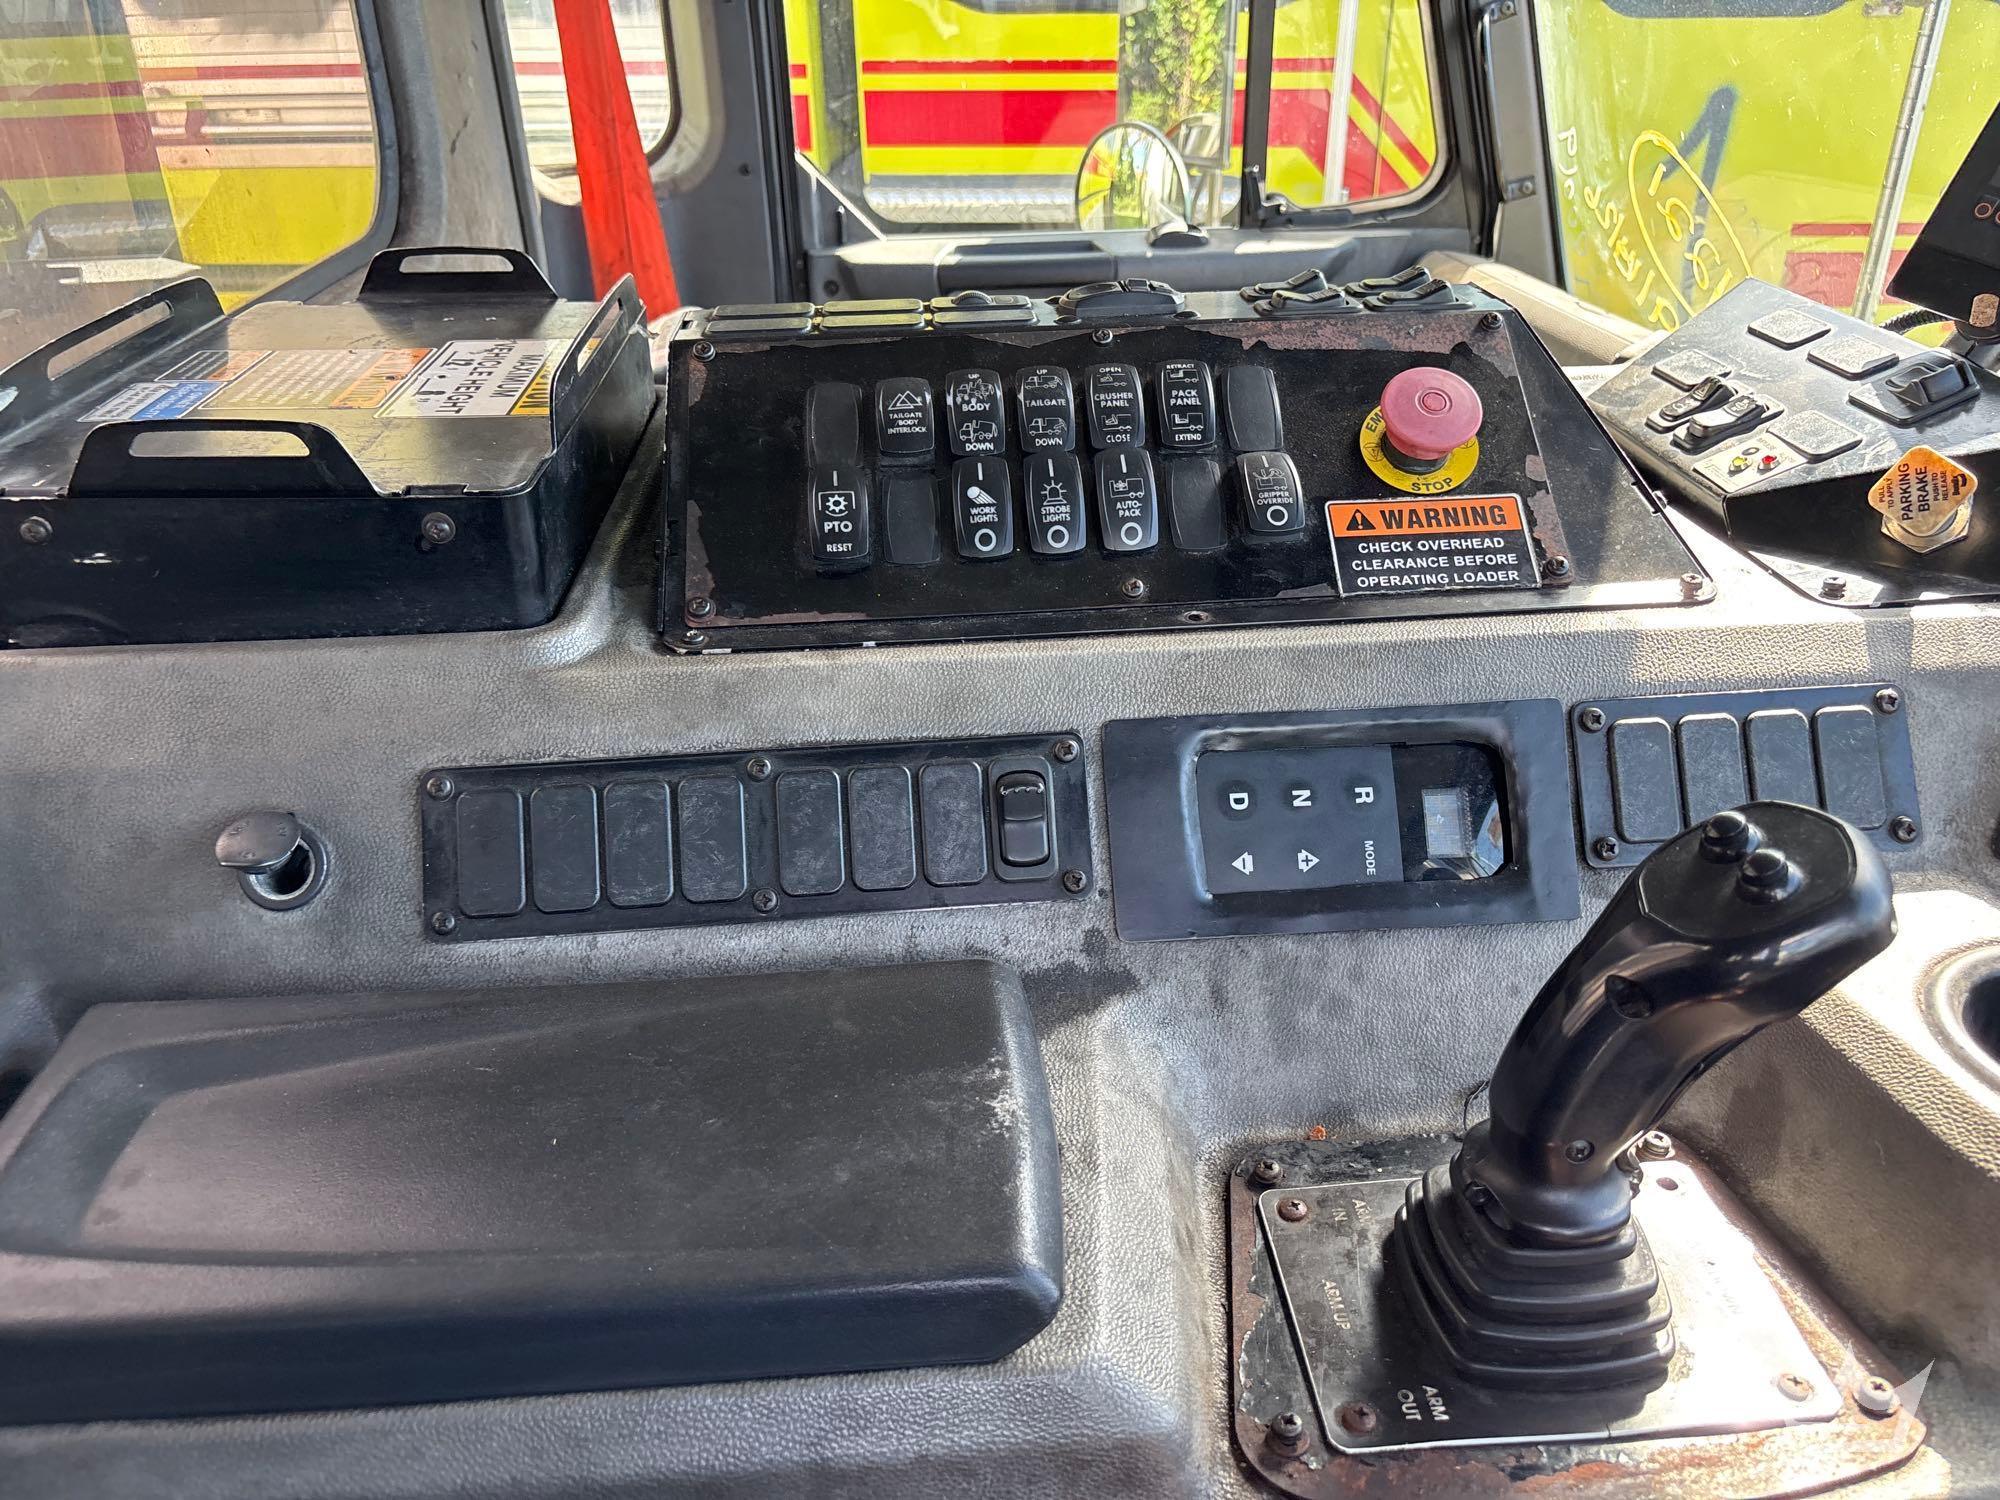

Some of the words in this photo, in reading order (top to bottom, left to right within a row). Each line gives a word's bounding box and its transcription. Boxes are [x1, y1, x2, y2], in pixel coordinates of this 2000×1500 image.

[468, 340, 516, 377] VEHICLE
[490, 354, 542, 398] MAXIMUM
[435, 379, 488, 414] HEIGHT
[1094, 393, 1134, 401] CRUSHER
[1171, 389, 1198, 397] PACK
[962, 403, 990, 412] BODY
[1025, 399, 1067, 407] TAILGATE
[1101, 399, 1129, 408] PANEL
[1170, 397, 1202, 406] PANEL
[888, 426, 927, 435] INTERLOCK
[1035, 438, 1063, 447] DOWN
[1105, 434, 1131, 443] CLOSE
[1175, 434, 1202, 442] EXTEND
[965, 442, 994, 452] DOWN
[1411, 476, 1453, 492] STOP
[1885, 478, 1894, 499] APPLY
[1915, 466, 1931, 512] BRAKE
[1940, 470, 1948, 501] RELEASE
[1258, 491, 1290, 499] GRIPPER
[1897, 463, 1914, 521] PARKING
[1932, 483, 1940, 502] PUSH
[1115, 500, 1143, 510] AUTO-
[1257, 497, 1294, 505] OVERRIDE
[969, 506, 997, 516] WORK
[1040, 505, 1071, 515] STROBE
[1118, 508, 1142, 518] PACK
[970, 514, 999, 524] LIGHTS
[1042, 513, 1071, 523] LIGHTS
[1379, 504, 1508, 530] WARNING
[824, 520, 853, 533] PTO
[826, 543, 853, 553] RESET
[1358, 541, 1414, 554] CHECK
[1417, 537, 1505, 551] OVERHEAD
[1352, 556, 1449, 571] CLEARANCE
[1454, 553, 1518, 566] BEFORE
[1357, 573, 1449, 588] OPERATING
[1454, 570, 1519, 583] LOADER
[1228, 792, 1249, 810] D
[1291, 789, 1312, 807] N
[1354, 786, 1374, 804] R
[1364, 840, 1376, 876] MODE
[1331, 1208, 1348, 1221] IN
[1333, 1313, 1351, 1330] UP
[1397, 1389, 1422, 1421] OUT
[1422, 1385, 1450, 1422] ARM
